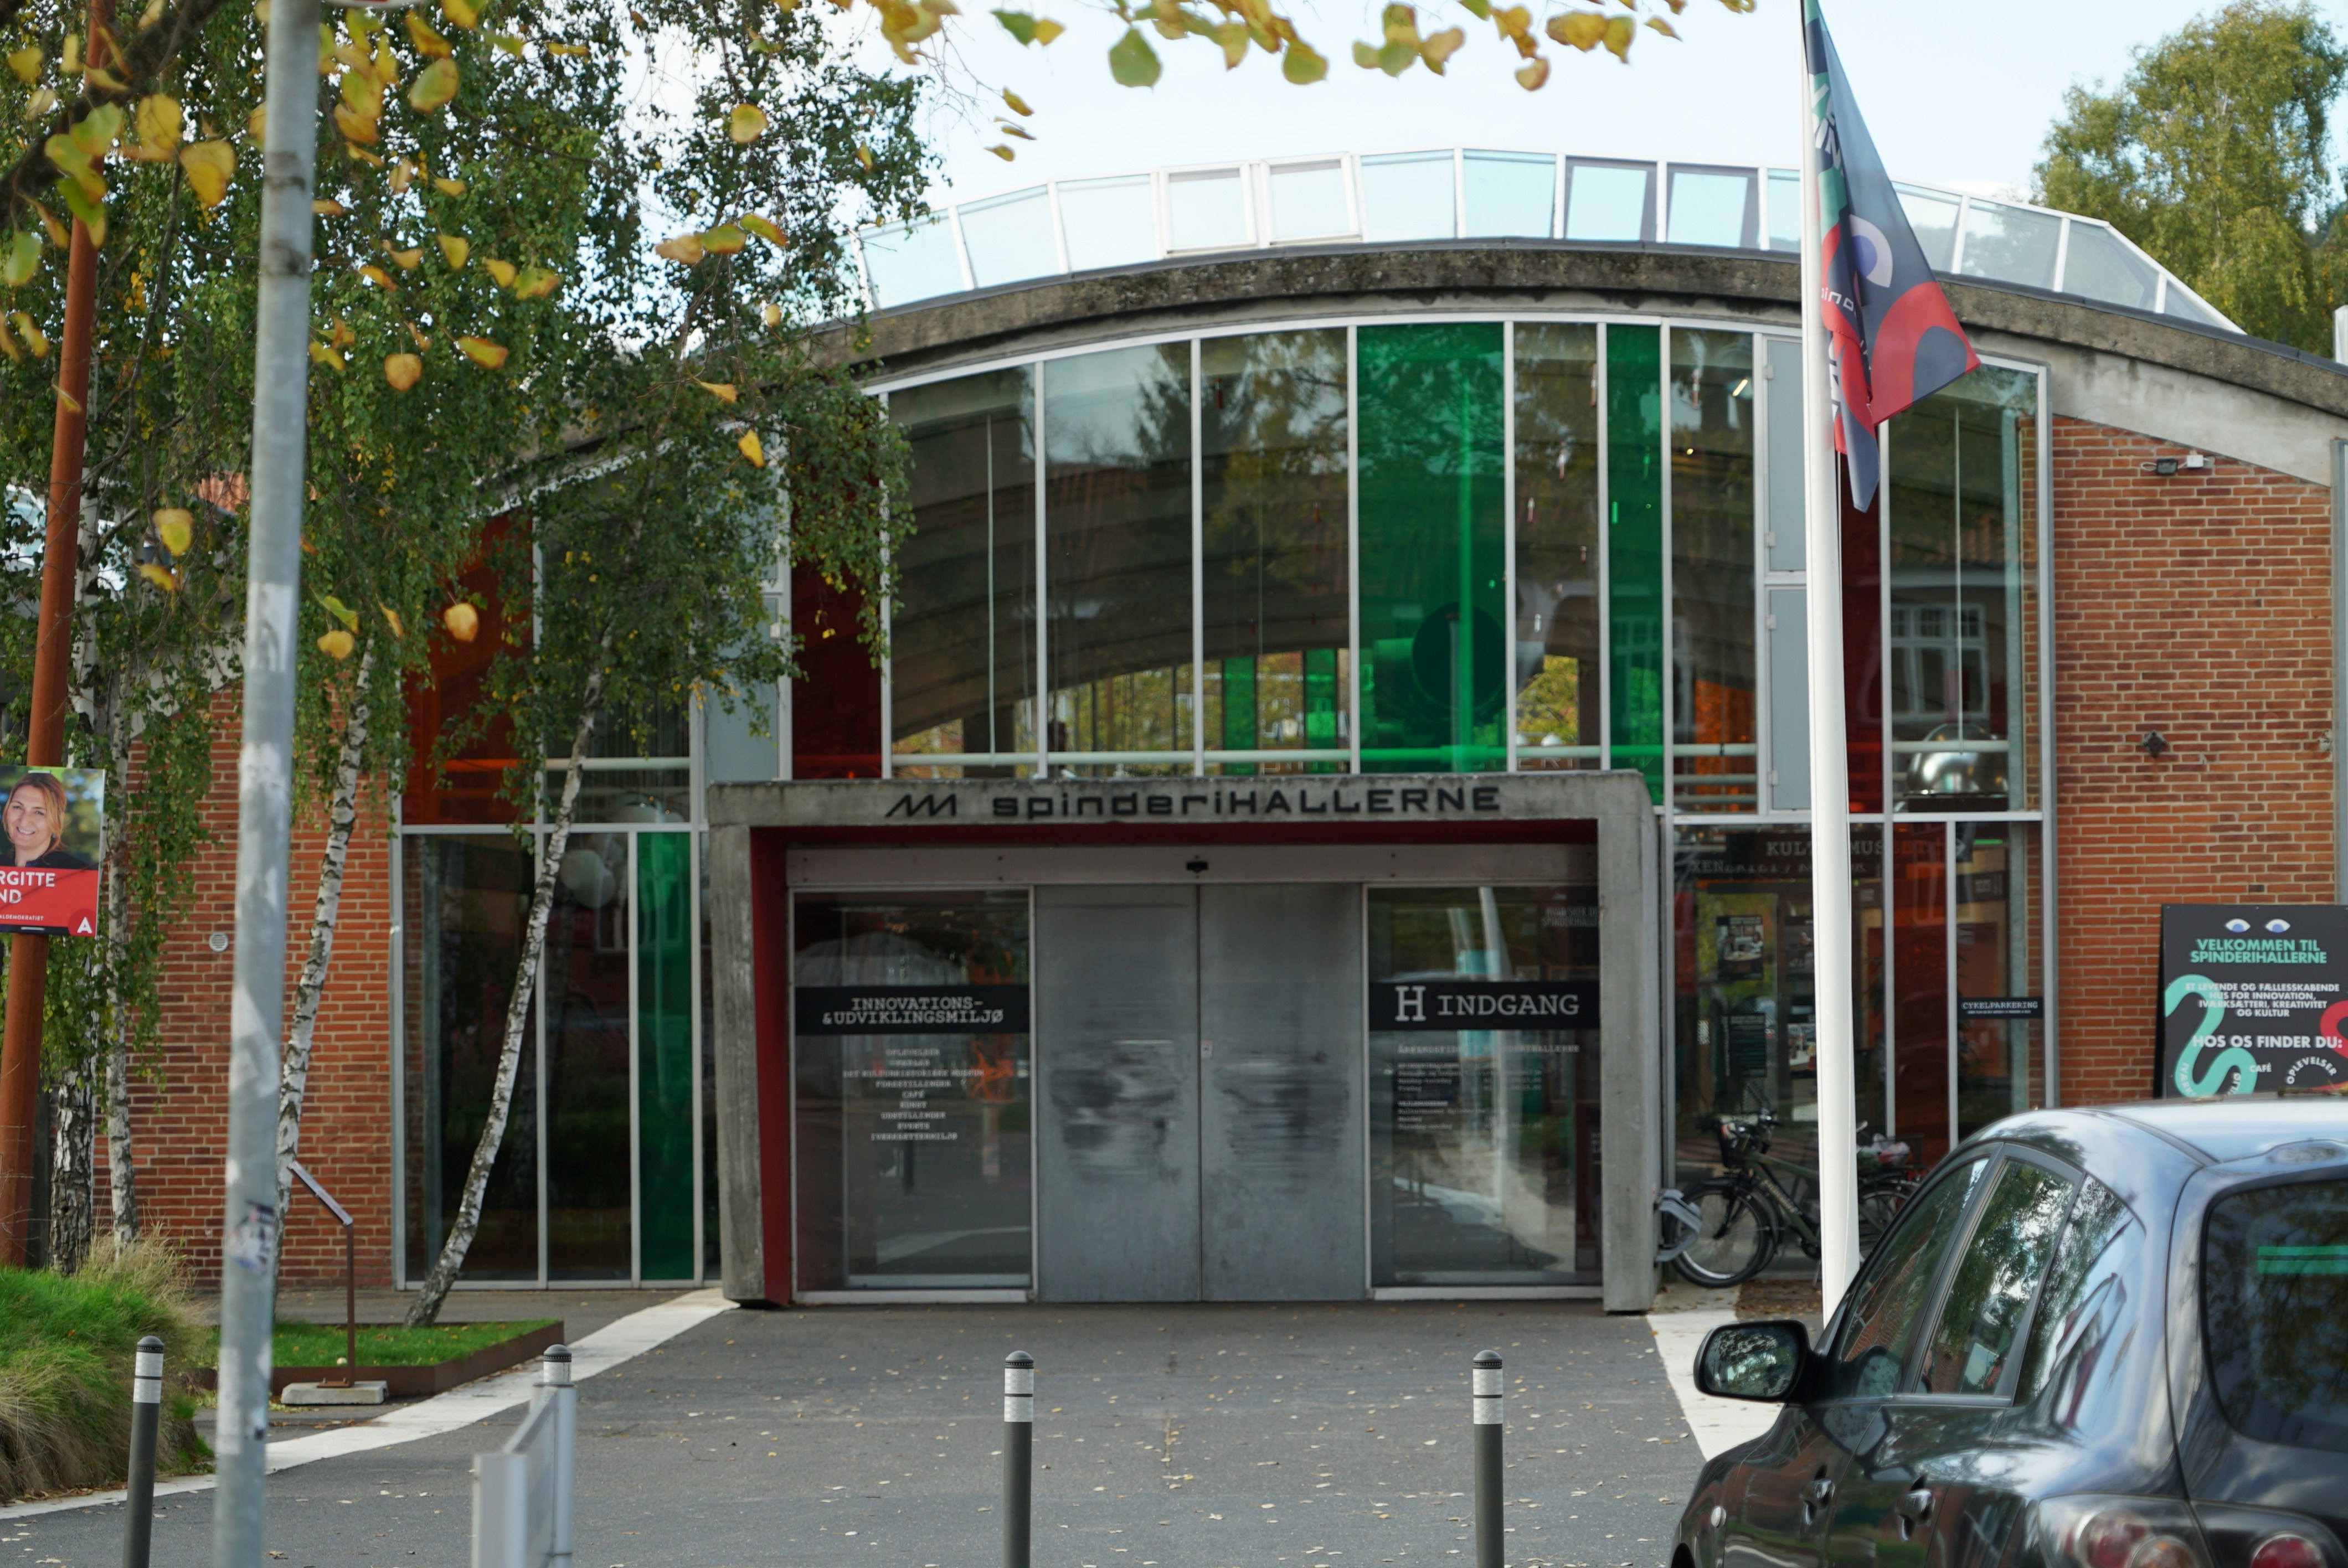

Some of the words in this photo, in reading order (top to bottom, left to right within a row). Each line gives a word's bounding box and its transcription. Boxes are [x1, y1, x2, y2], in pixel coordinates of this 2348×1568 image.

[76, 916, 92, 933] A
[2196, 938, 2296, 951] VELKOMMEN
[2300, 940, 2320, 951] TIL
[2190, 951, 2327, 963] SPINDERIHALLERNE
[2259, 983, 2340, 992] FÆLLESSKABENDE
[2252, 992, 2316, 1001] INNOVATION,
[1394, 986, 1426, 1022] H
[1438, 995, 1579, 1015] INDGANG
[1962, 1001, 2038, 1009] CYKELPARKERING
[2199, 1000, 2270, 1009] IVÆRKSÆTTERI,
[2272, 1000, 2328, 1009] KREATIVITET
[2193, 1035, 2226, 1048] HOS
[2231, 1035, 2253, 1048] OS
[2257, 1036, 2311, 1048] FINDER
[2315, 1036, 2343, 1049] DU:
[2249, 1062, 2272, 1072] CAFÉ
[2286, 1056, 2337, 1085] OPLEVELSER
